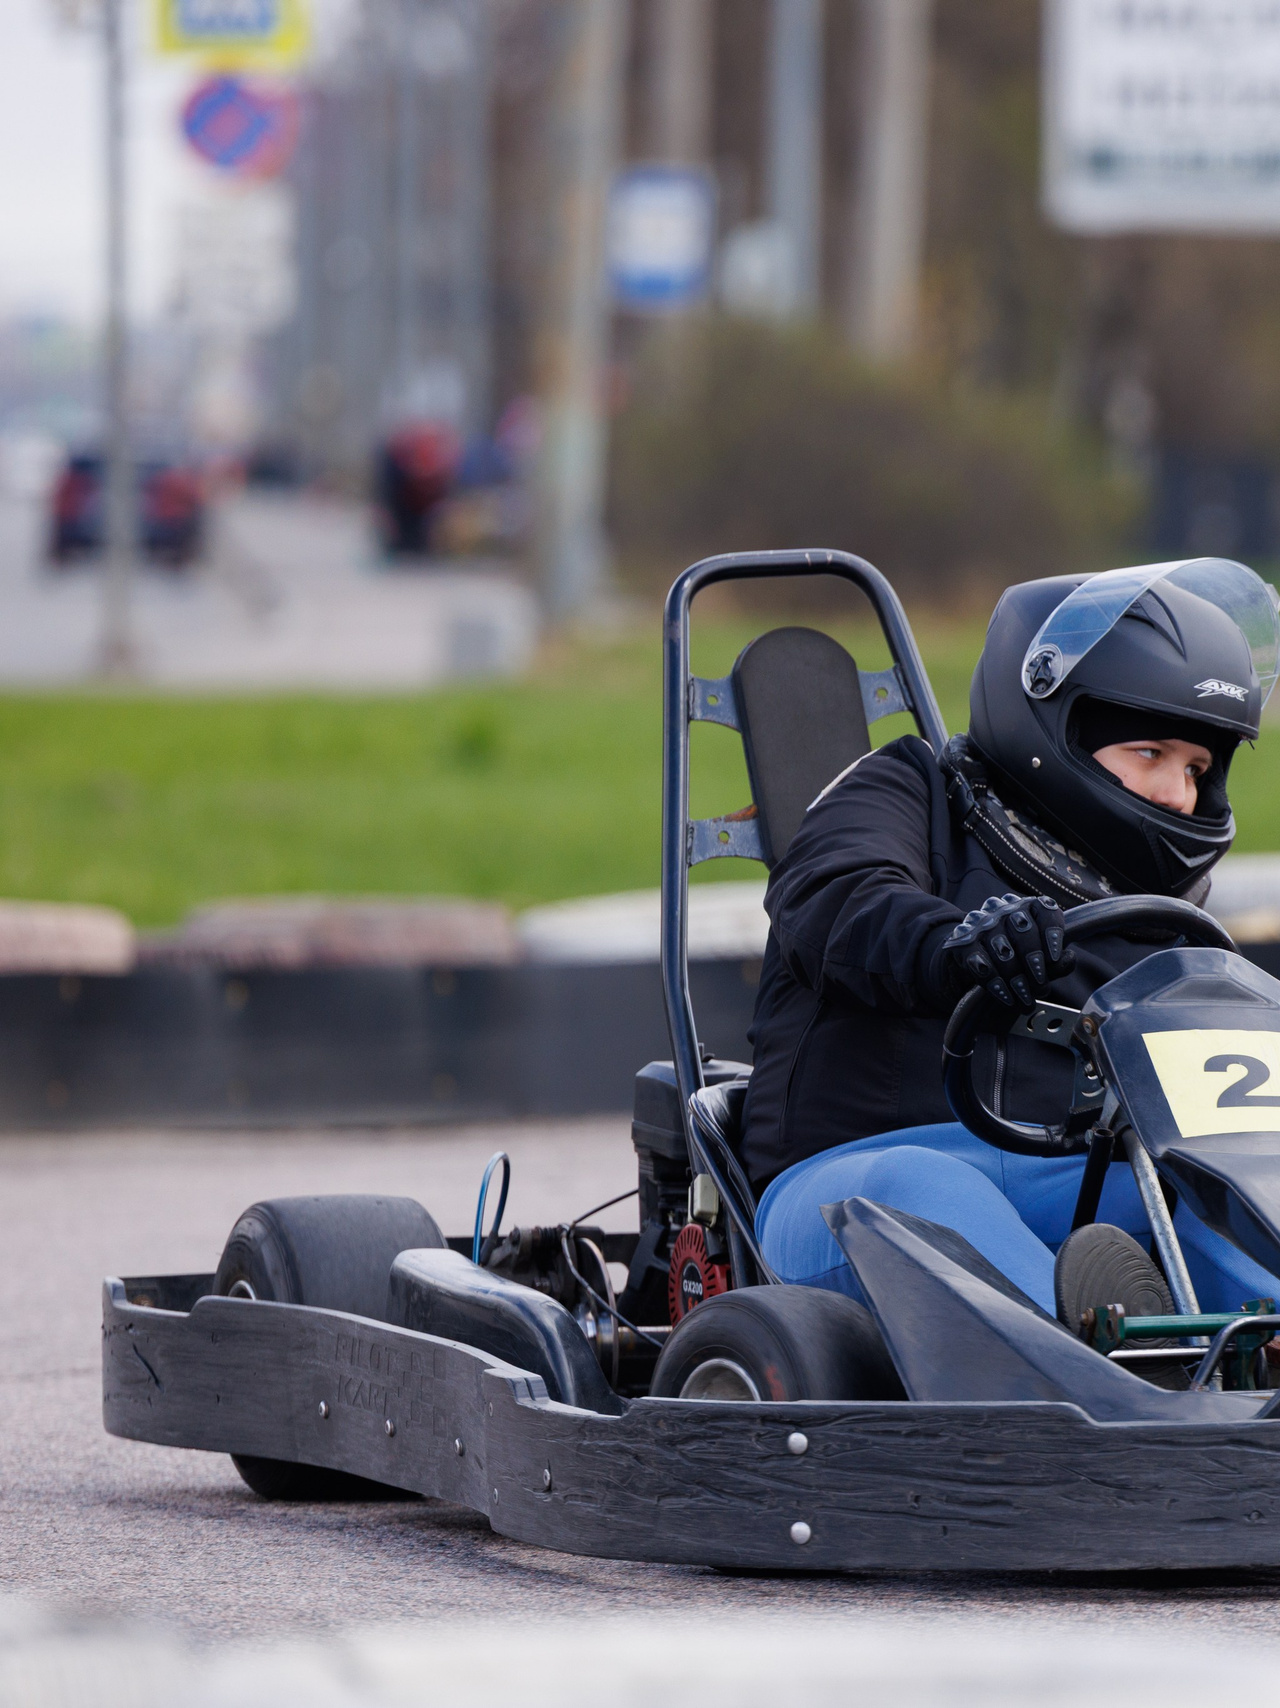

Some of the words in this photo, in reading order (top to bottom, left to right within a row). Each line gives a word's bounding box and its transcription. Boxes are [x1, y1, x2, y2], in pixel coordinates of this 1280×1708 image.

[683, 1279, 703, 1296] GX200
[335, 1333, 399, 1376] PILOT
[337, 1375, 395, 1417] KART
